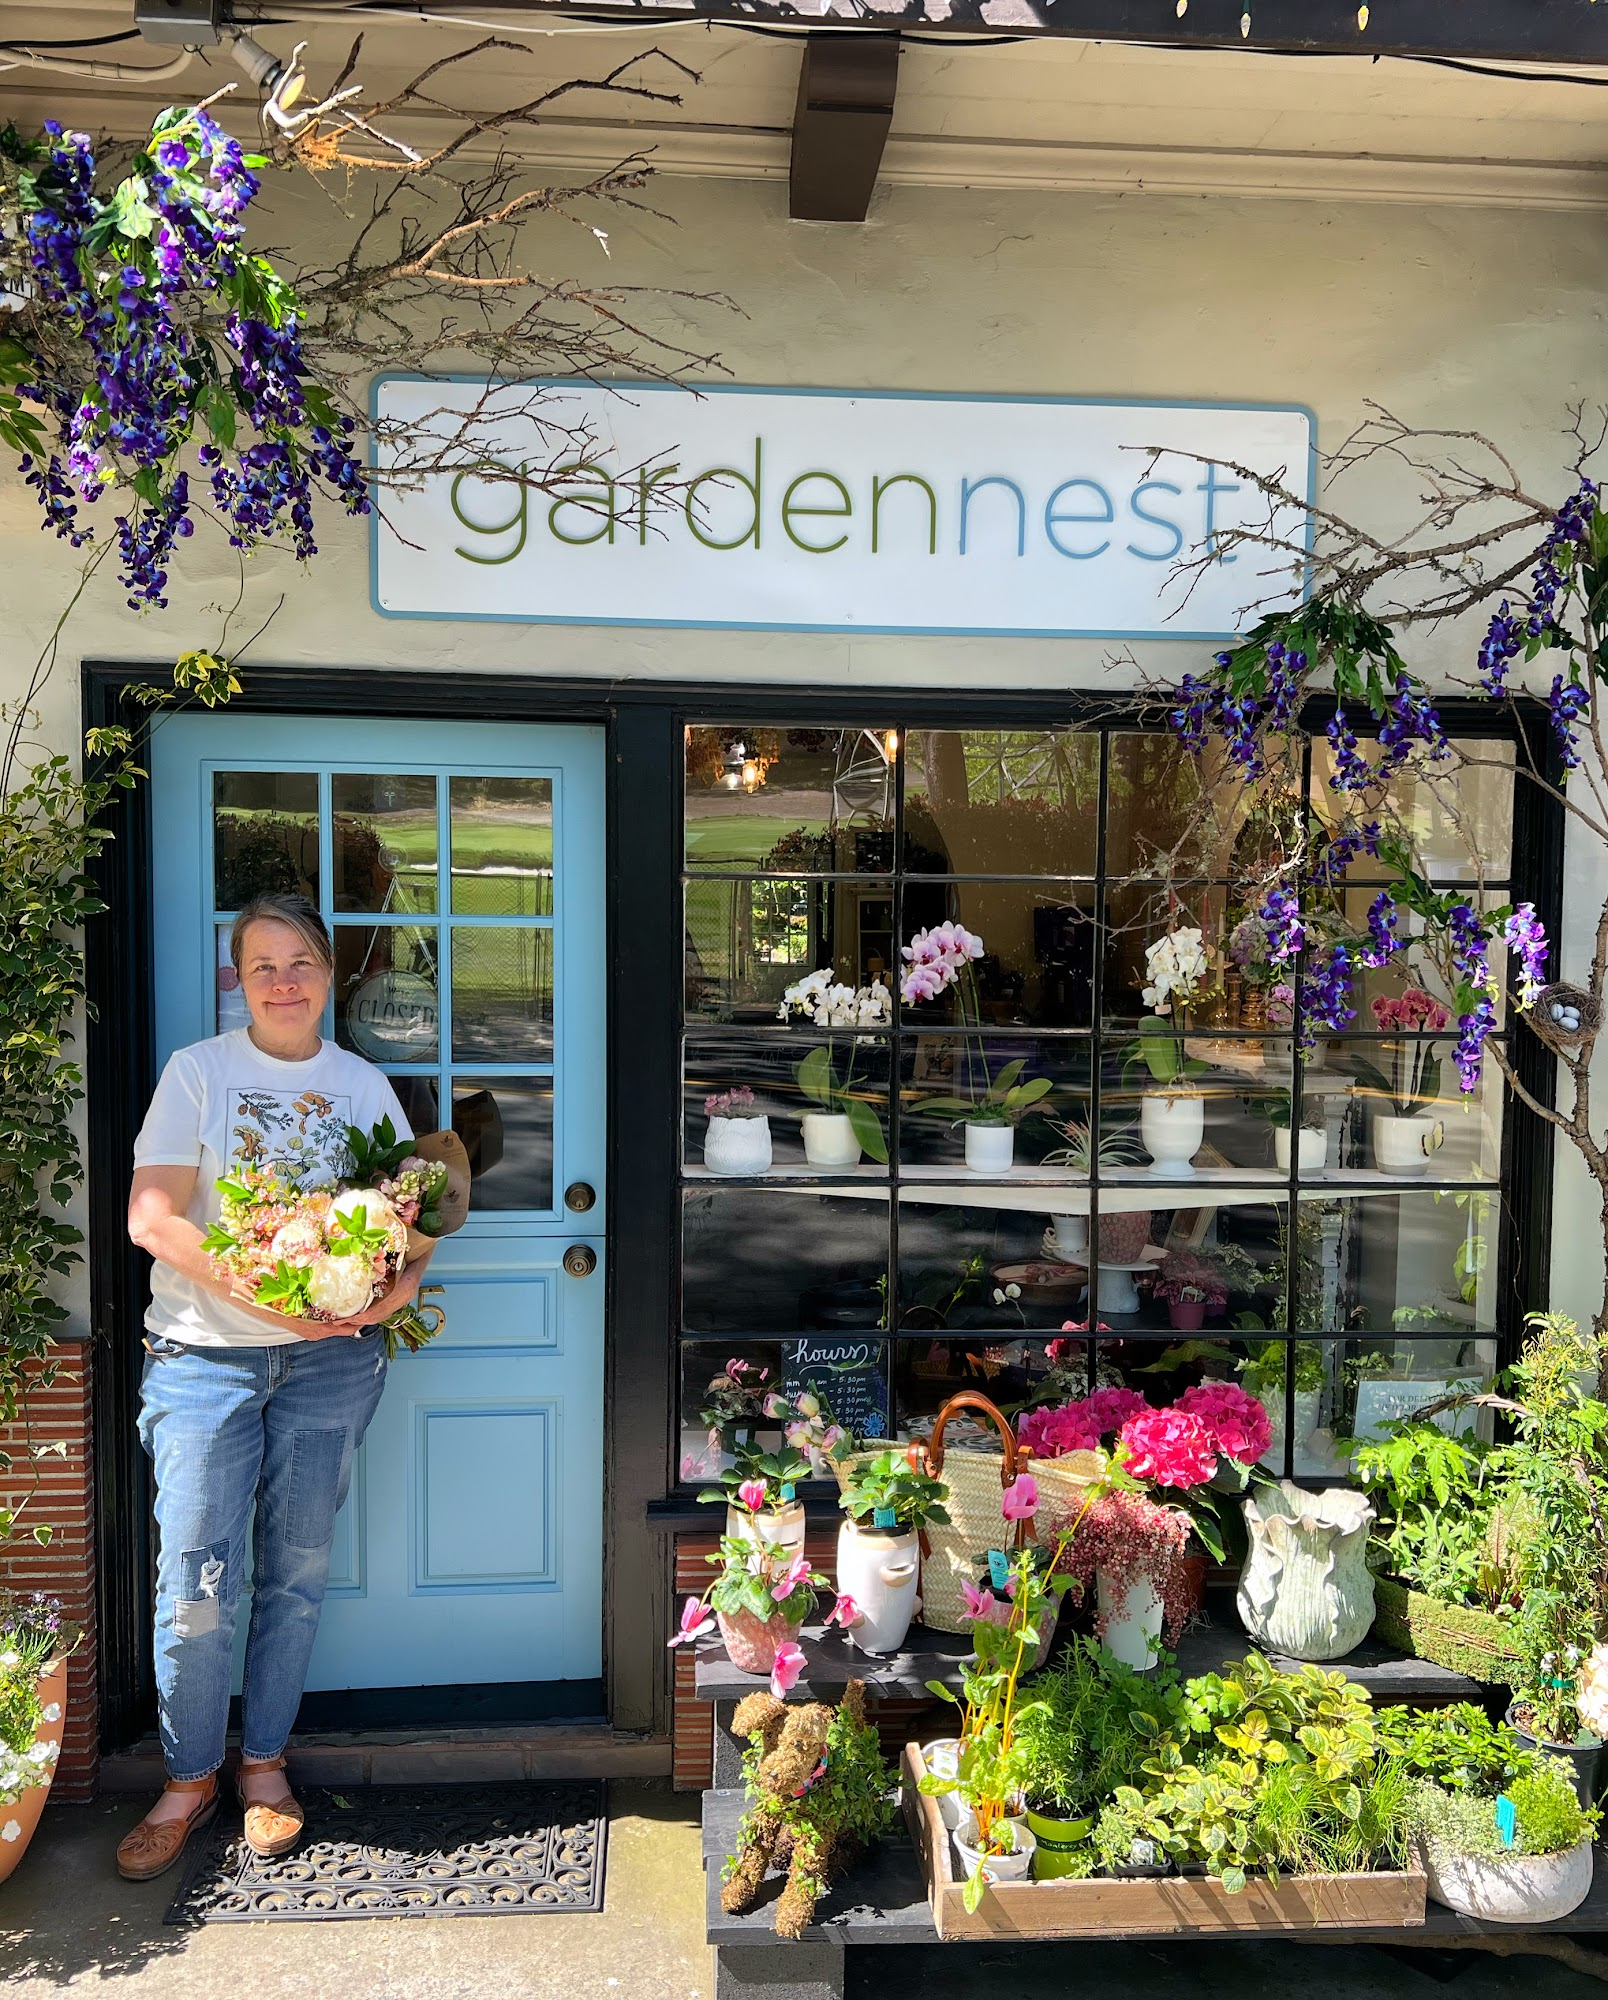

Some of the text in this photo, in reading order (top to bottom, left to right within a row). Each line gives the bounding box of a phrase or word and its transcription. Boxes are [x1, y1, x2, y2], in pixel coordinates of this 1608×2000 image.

[450, 436, 1239, 566] gardennest
[358, 999, 436, 1027] CLOSED
[418, 1285, 446, 1337] 5
[788, 1339, 869, 1374] hours
